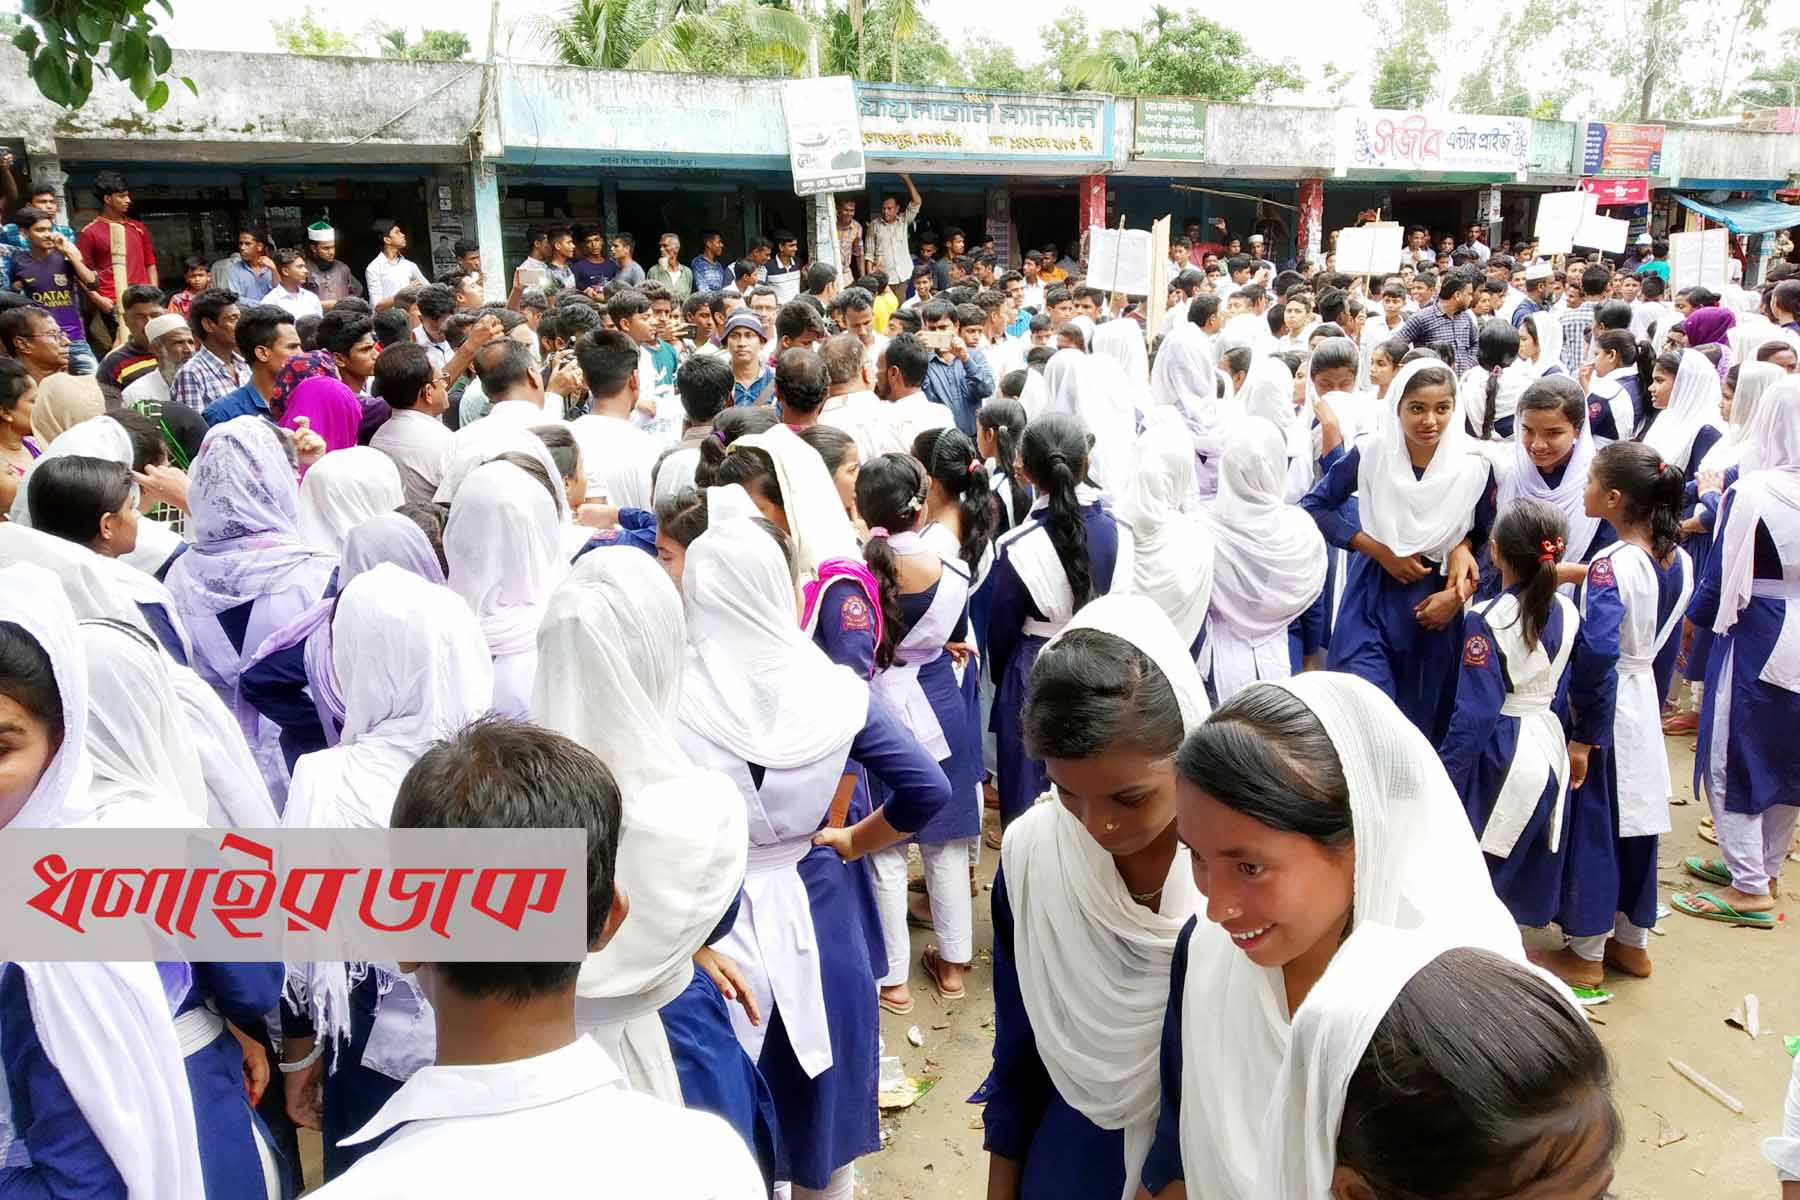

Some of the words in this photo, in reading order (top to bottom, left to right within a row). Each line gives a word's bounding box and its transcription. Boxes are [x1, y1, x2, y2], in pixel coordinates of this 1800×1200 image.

[1375, 115, 1443, 168] সজীব
[1446, 127, 1477, 151] এন্টার
[1478, 128, 1514, 154] প্রাইজ
[32, 289, 72, 304] QATAR
